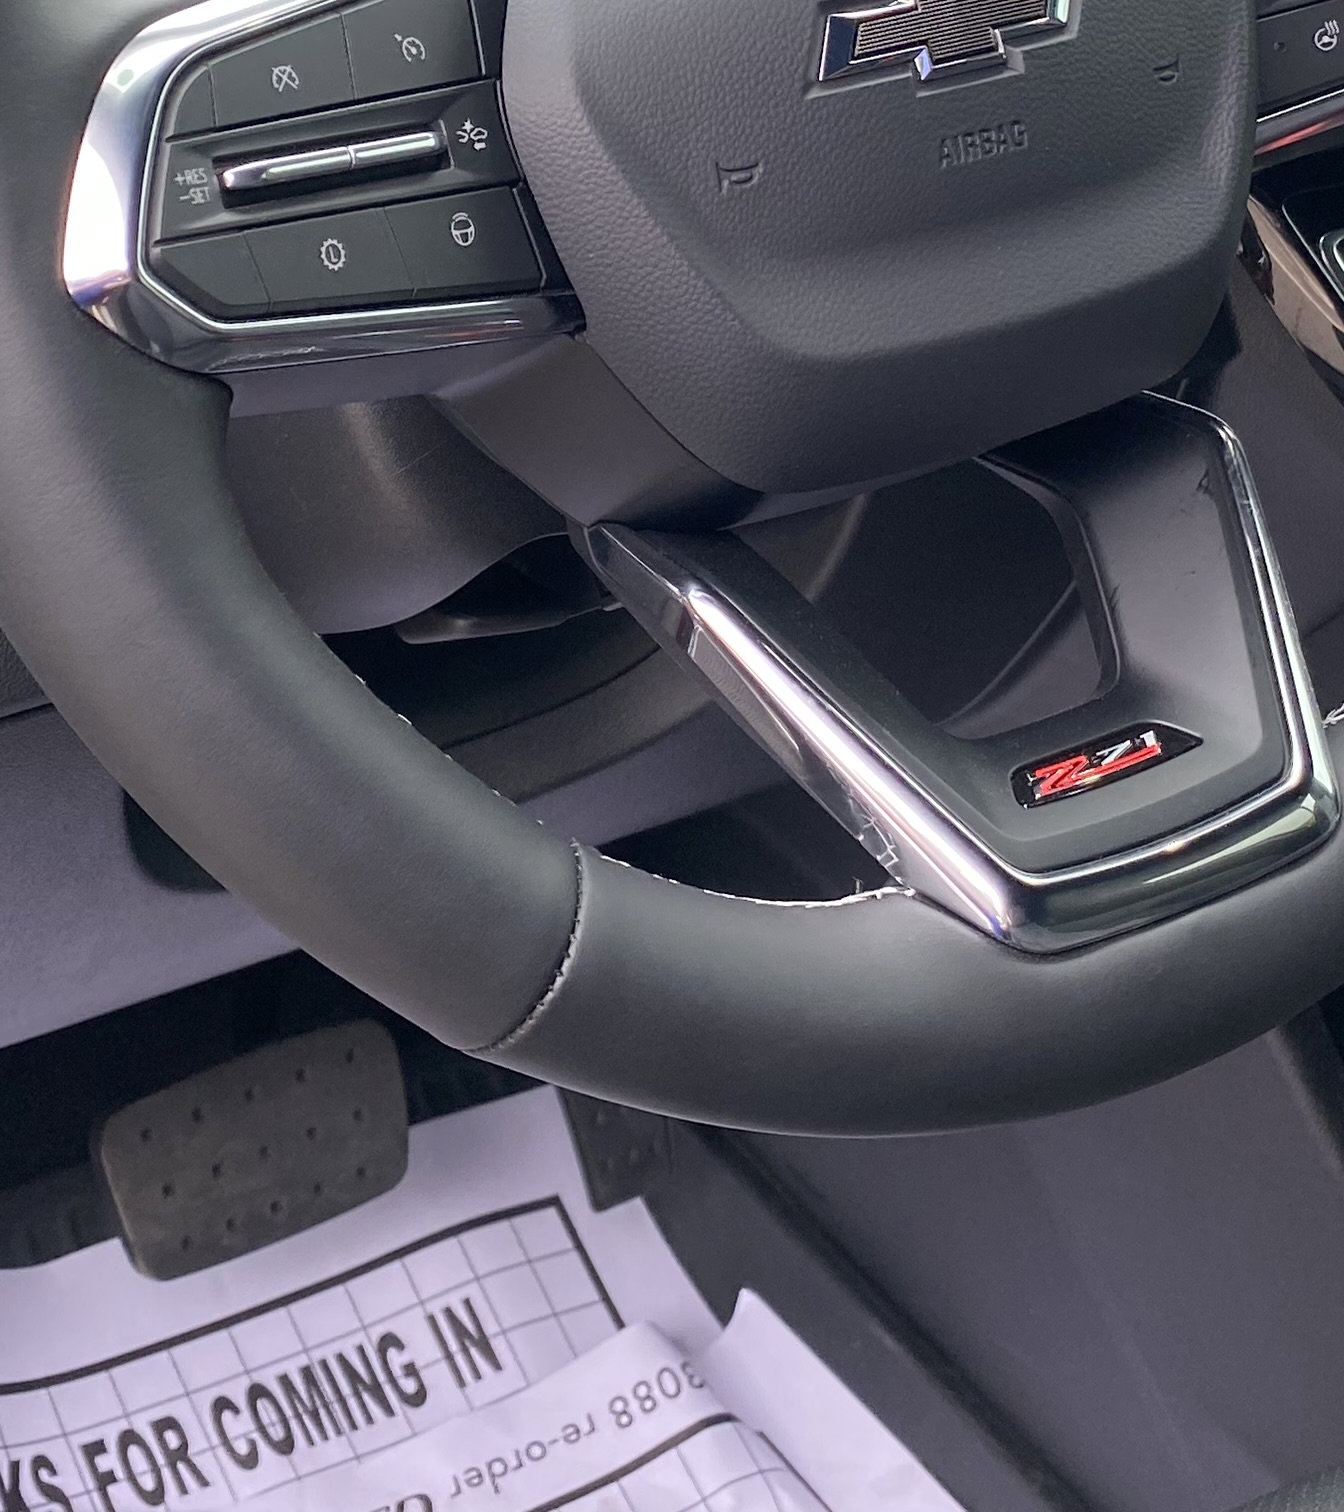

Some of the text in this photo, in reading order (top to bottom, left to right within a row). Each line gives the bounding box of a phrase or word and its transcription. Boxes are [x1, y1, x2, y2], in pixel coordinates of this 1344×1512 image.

[938, 118, 1030, 169] AIRBAG
[79, 1414, 211, 1512] FOR
[210, 1331, 429, 1470] COMING
[425, 1296, 504, 1388] IN
[449, 1412, 597, 1499] re-order
